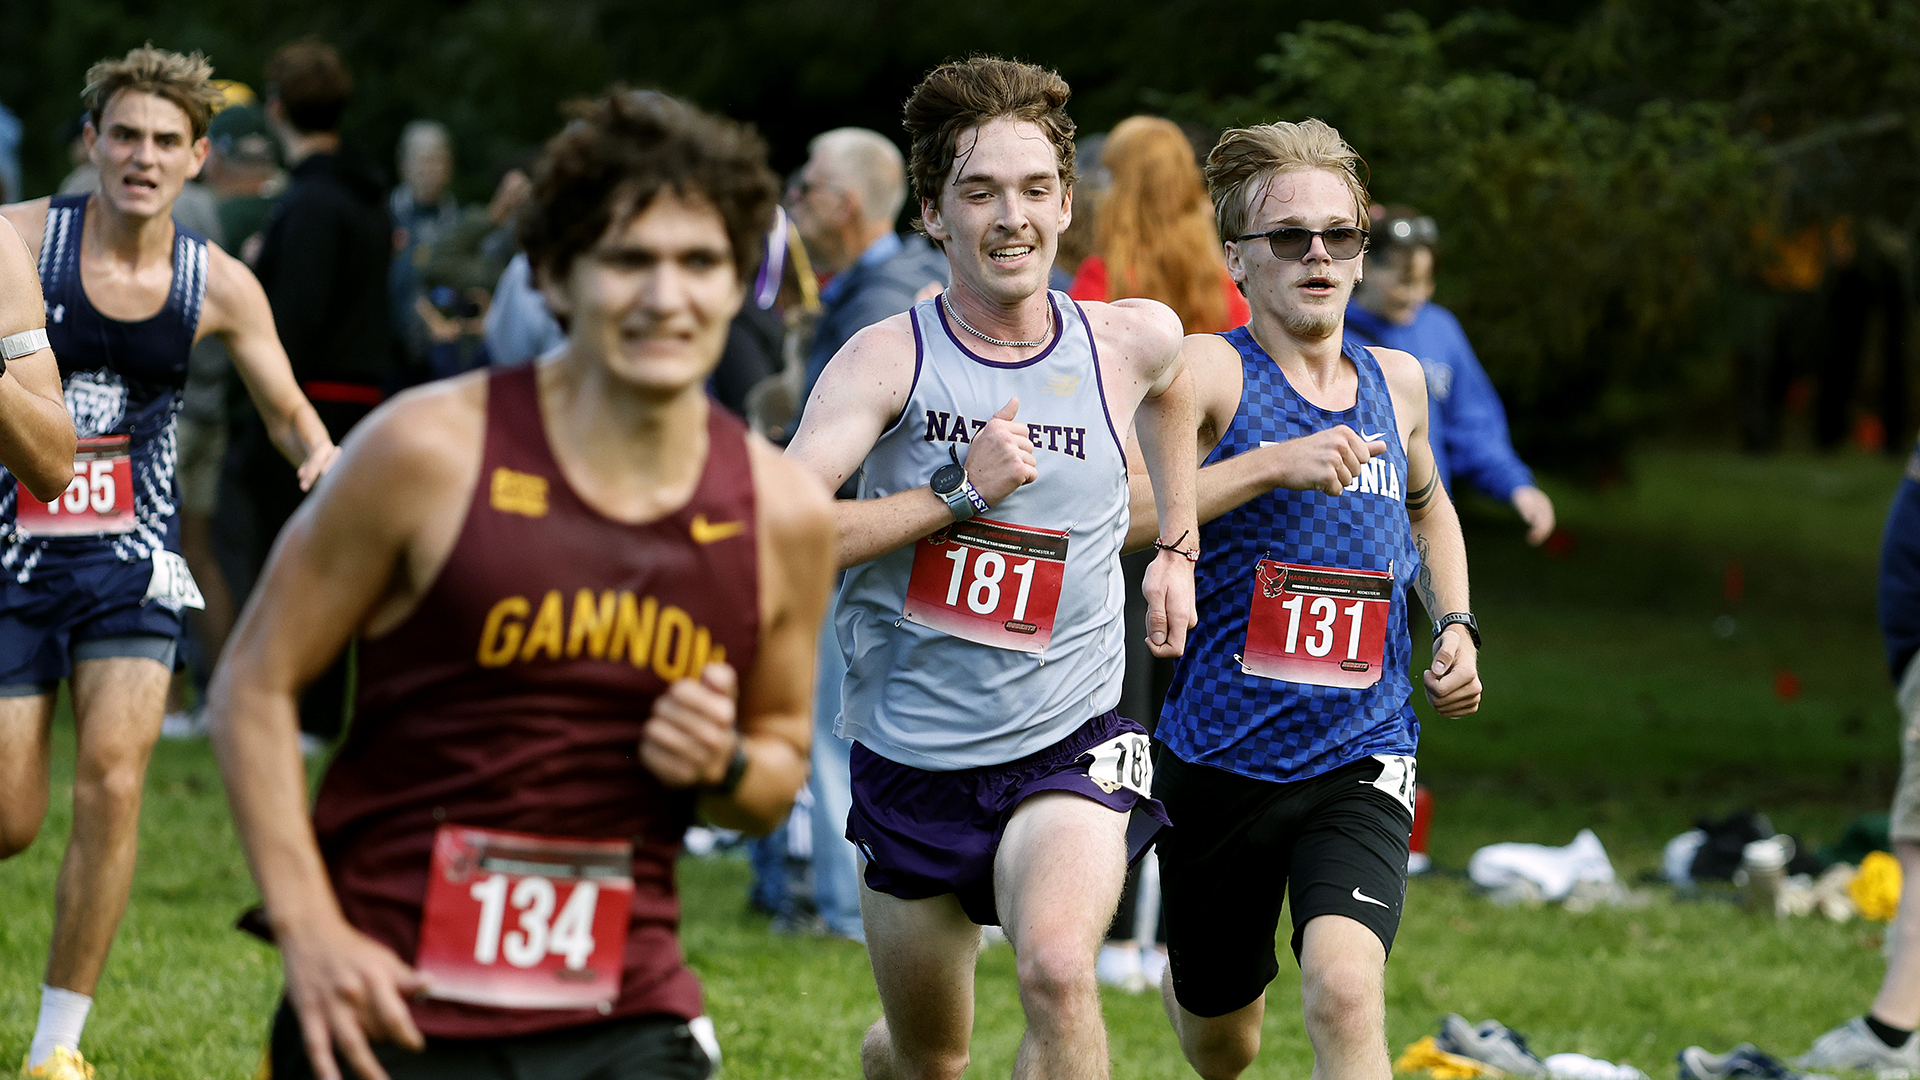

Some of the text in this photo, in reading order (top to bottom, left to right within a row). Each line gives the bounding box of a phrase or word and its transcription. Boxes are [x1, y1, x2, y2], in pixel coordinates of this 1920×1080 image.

[923, 409, 1087, 461] NAZETH
[47, 459, 116, 515] 55
[945, 547, 1036, 621] 181
[1288, 574, 1310, 582] HARRY
[1316, 577, 1350, 586] ANDERSON
[1281, 595, 1364, 660] 131
[469, 874, 599, 971] 134
